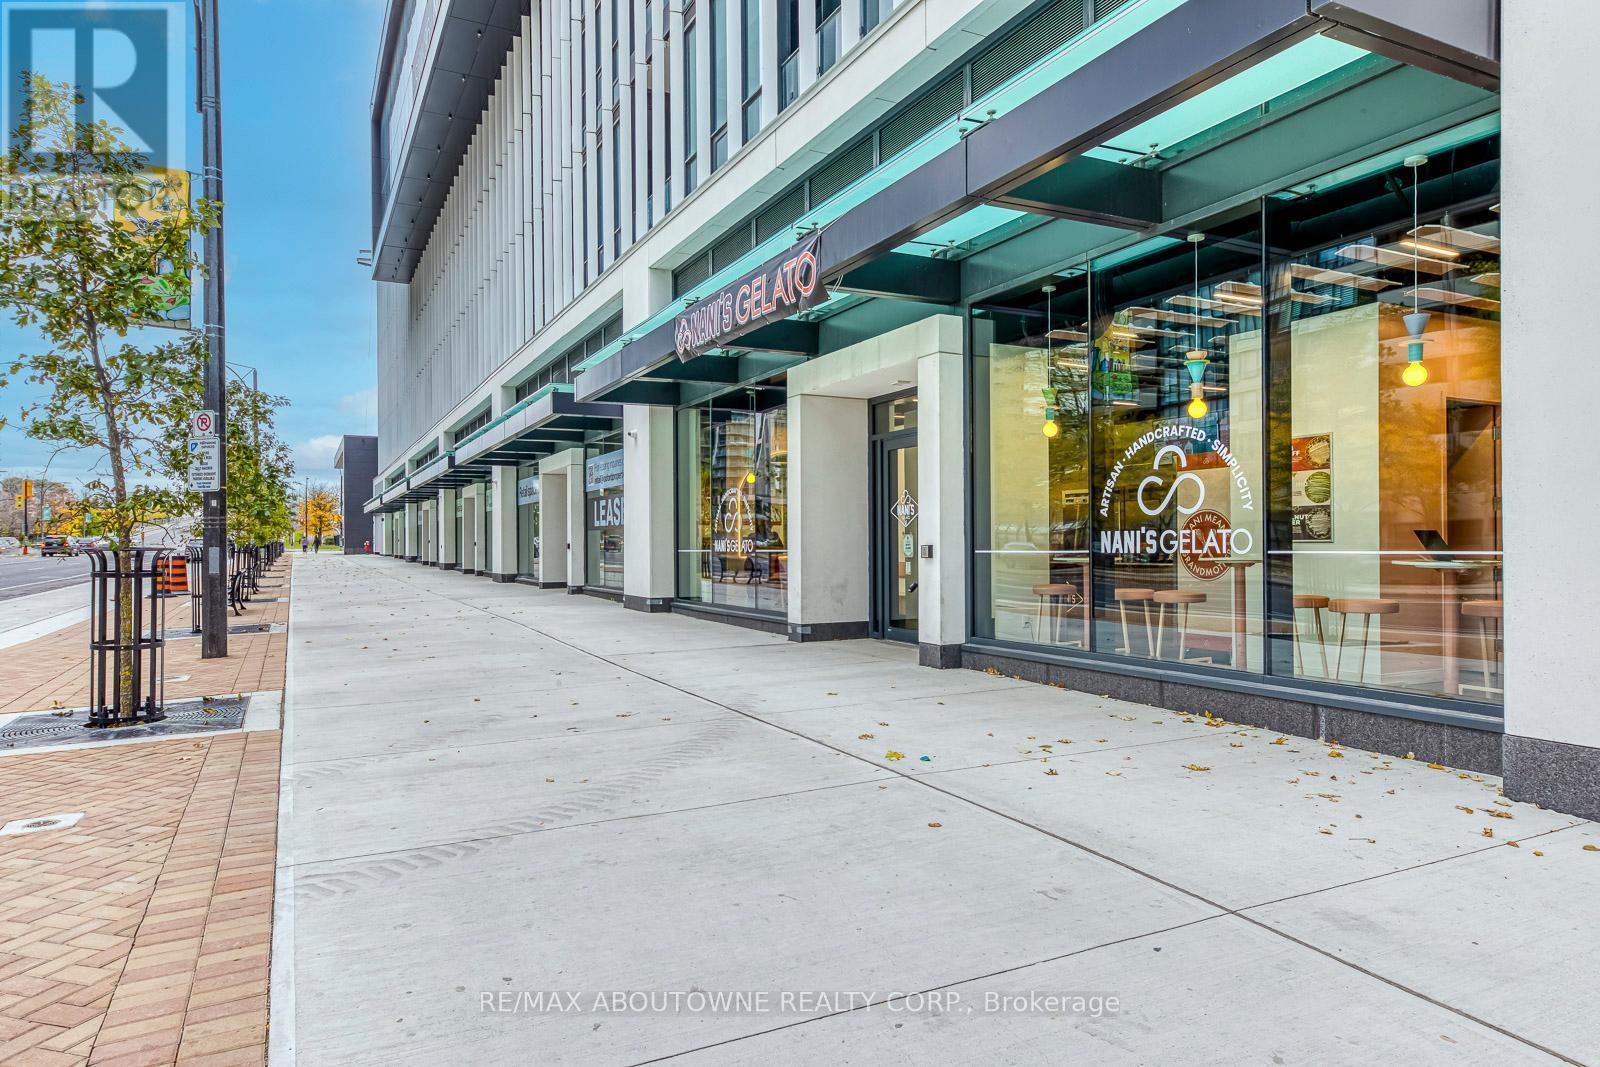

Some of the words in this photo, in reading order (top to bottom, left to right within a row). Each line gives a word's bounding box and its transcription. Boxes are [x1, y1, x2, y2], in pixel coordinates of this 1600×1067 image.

[691, 292, 733, 347] NANI'S
[735, 251, 817, 325] GELATO
[1100, 462, 1125, 517] ARTISAN
[1125, 426, 1207, 459] HANDCRAFTED
[1211, 439, 1254, 510] SIMPLICITY
[1100, 527, 1157, 554] NANI'S
[1159, 528, 1253, 555] GELATO
